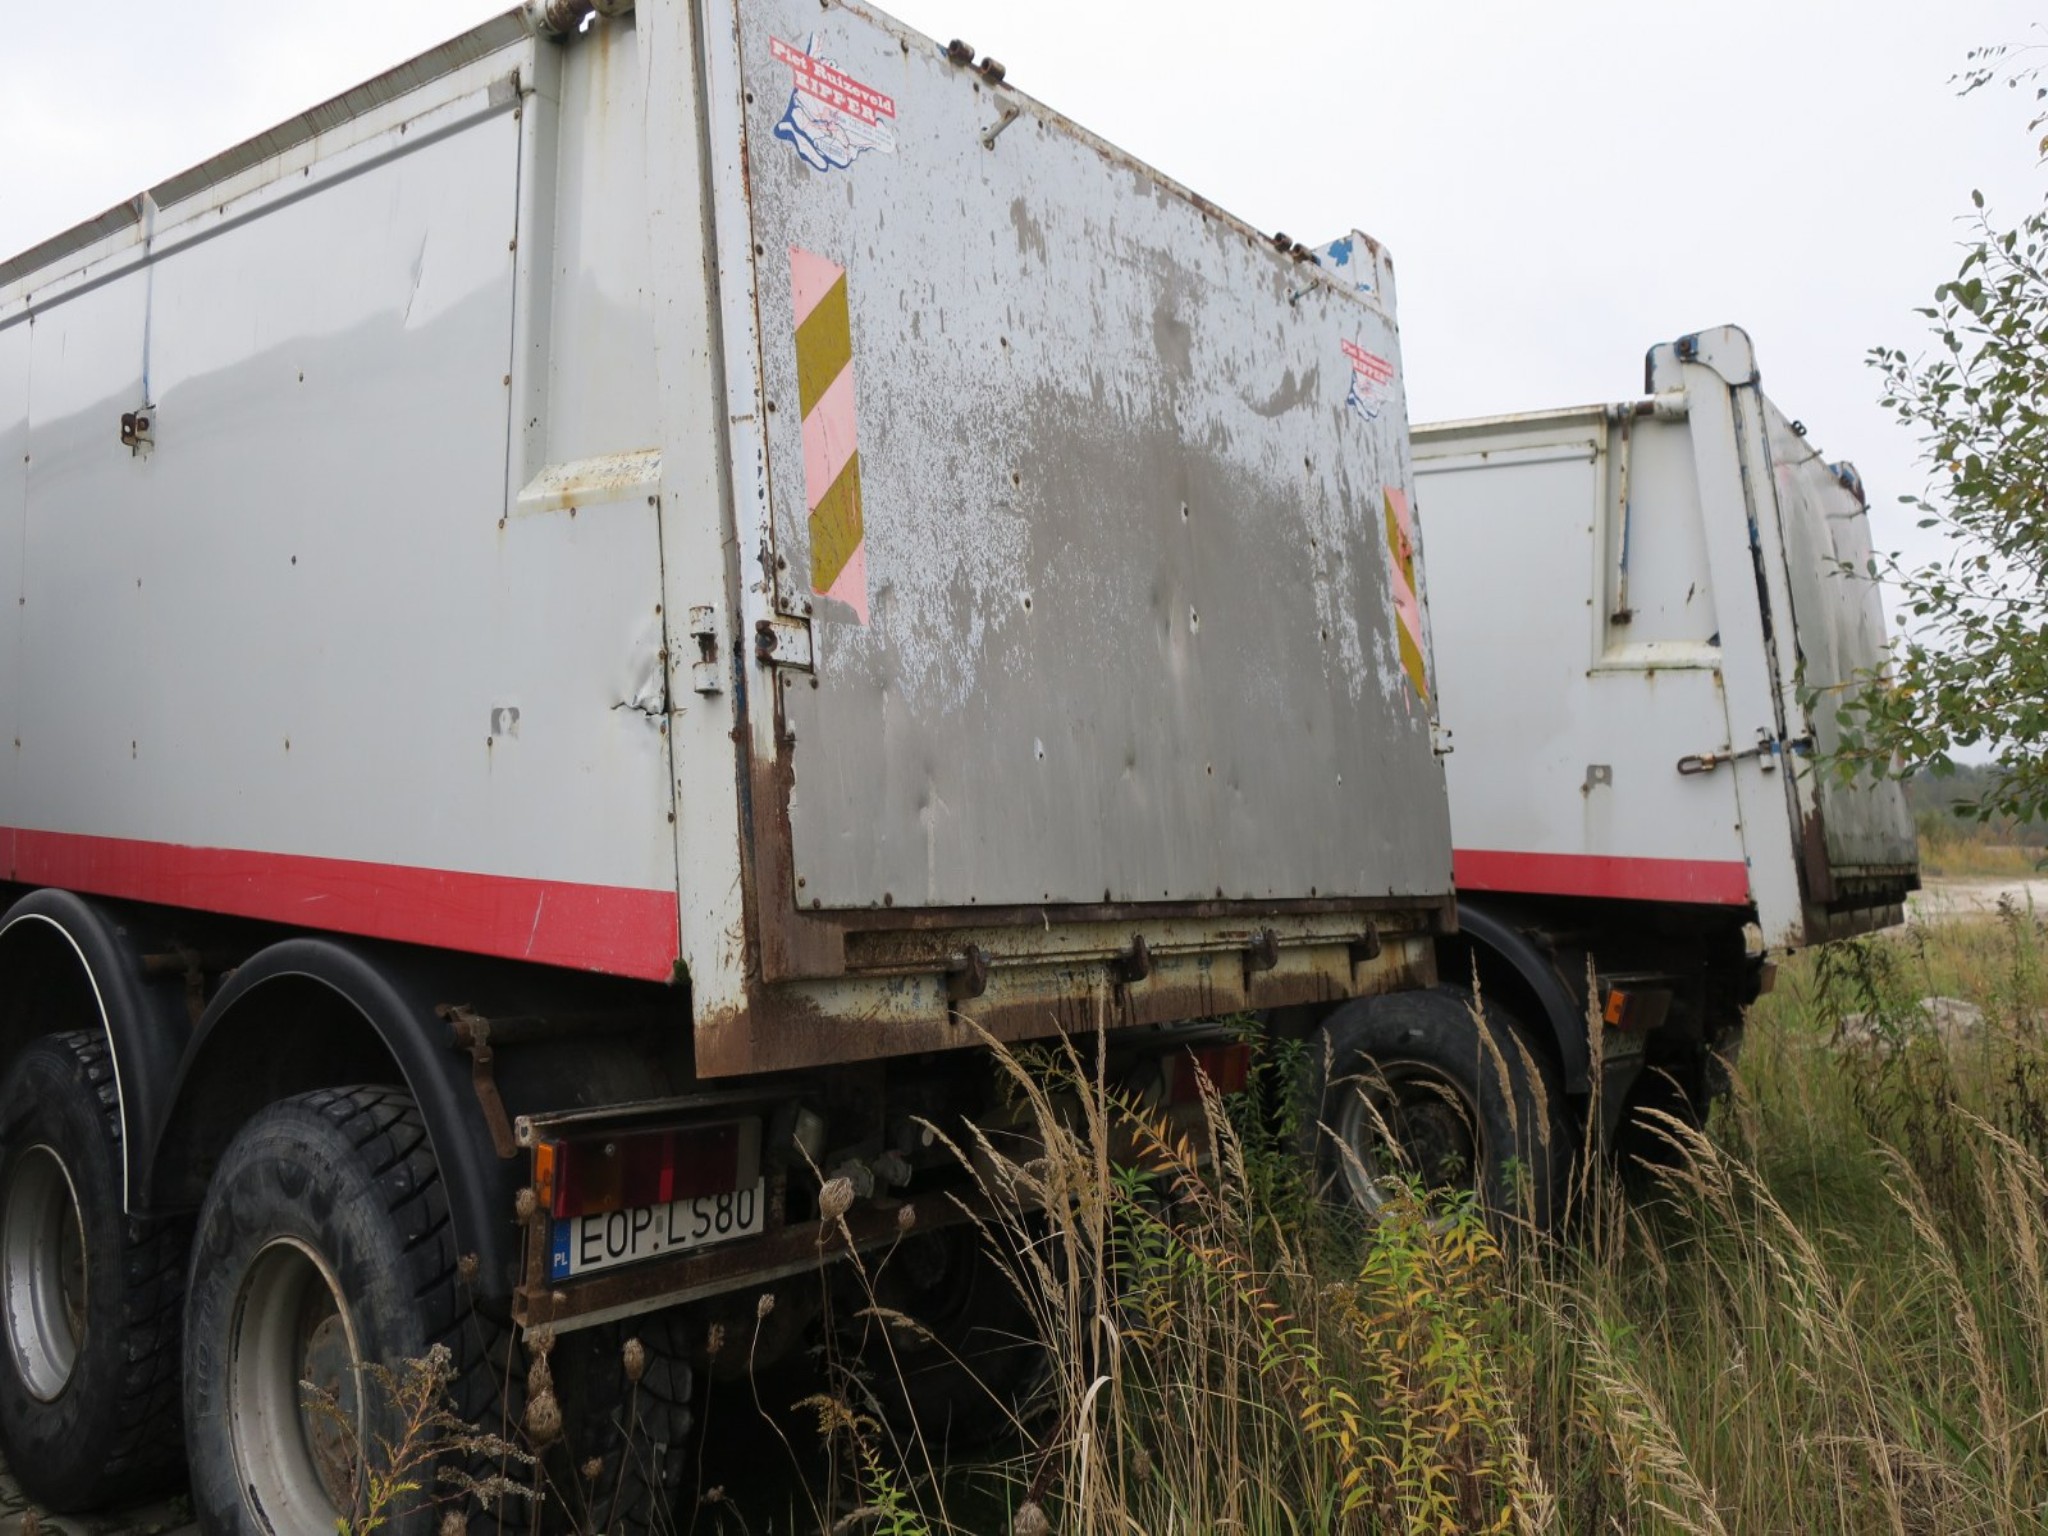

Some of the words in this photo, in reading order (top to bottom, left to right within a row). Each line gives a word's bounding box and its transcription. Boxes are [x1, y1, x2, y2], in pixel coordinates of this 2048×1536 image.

[579, 1207, 653, 1266] EOP
[667, 1188, 755, 1245] LS80
[554, 1253, 568, 1267] PL
